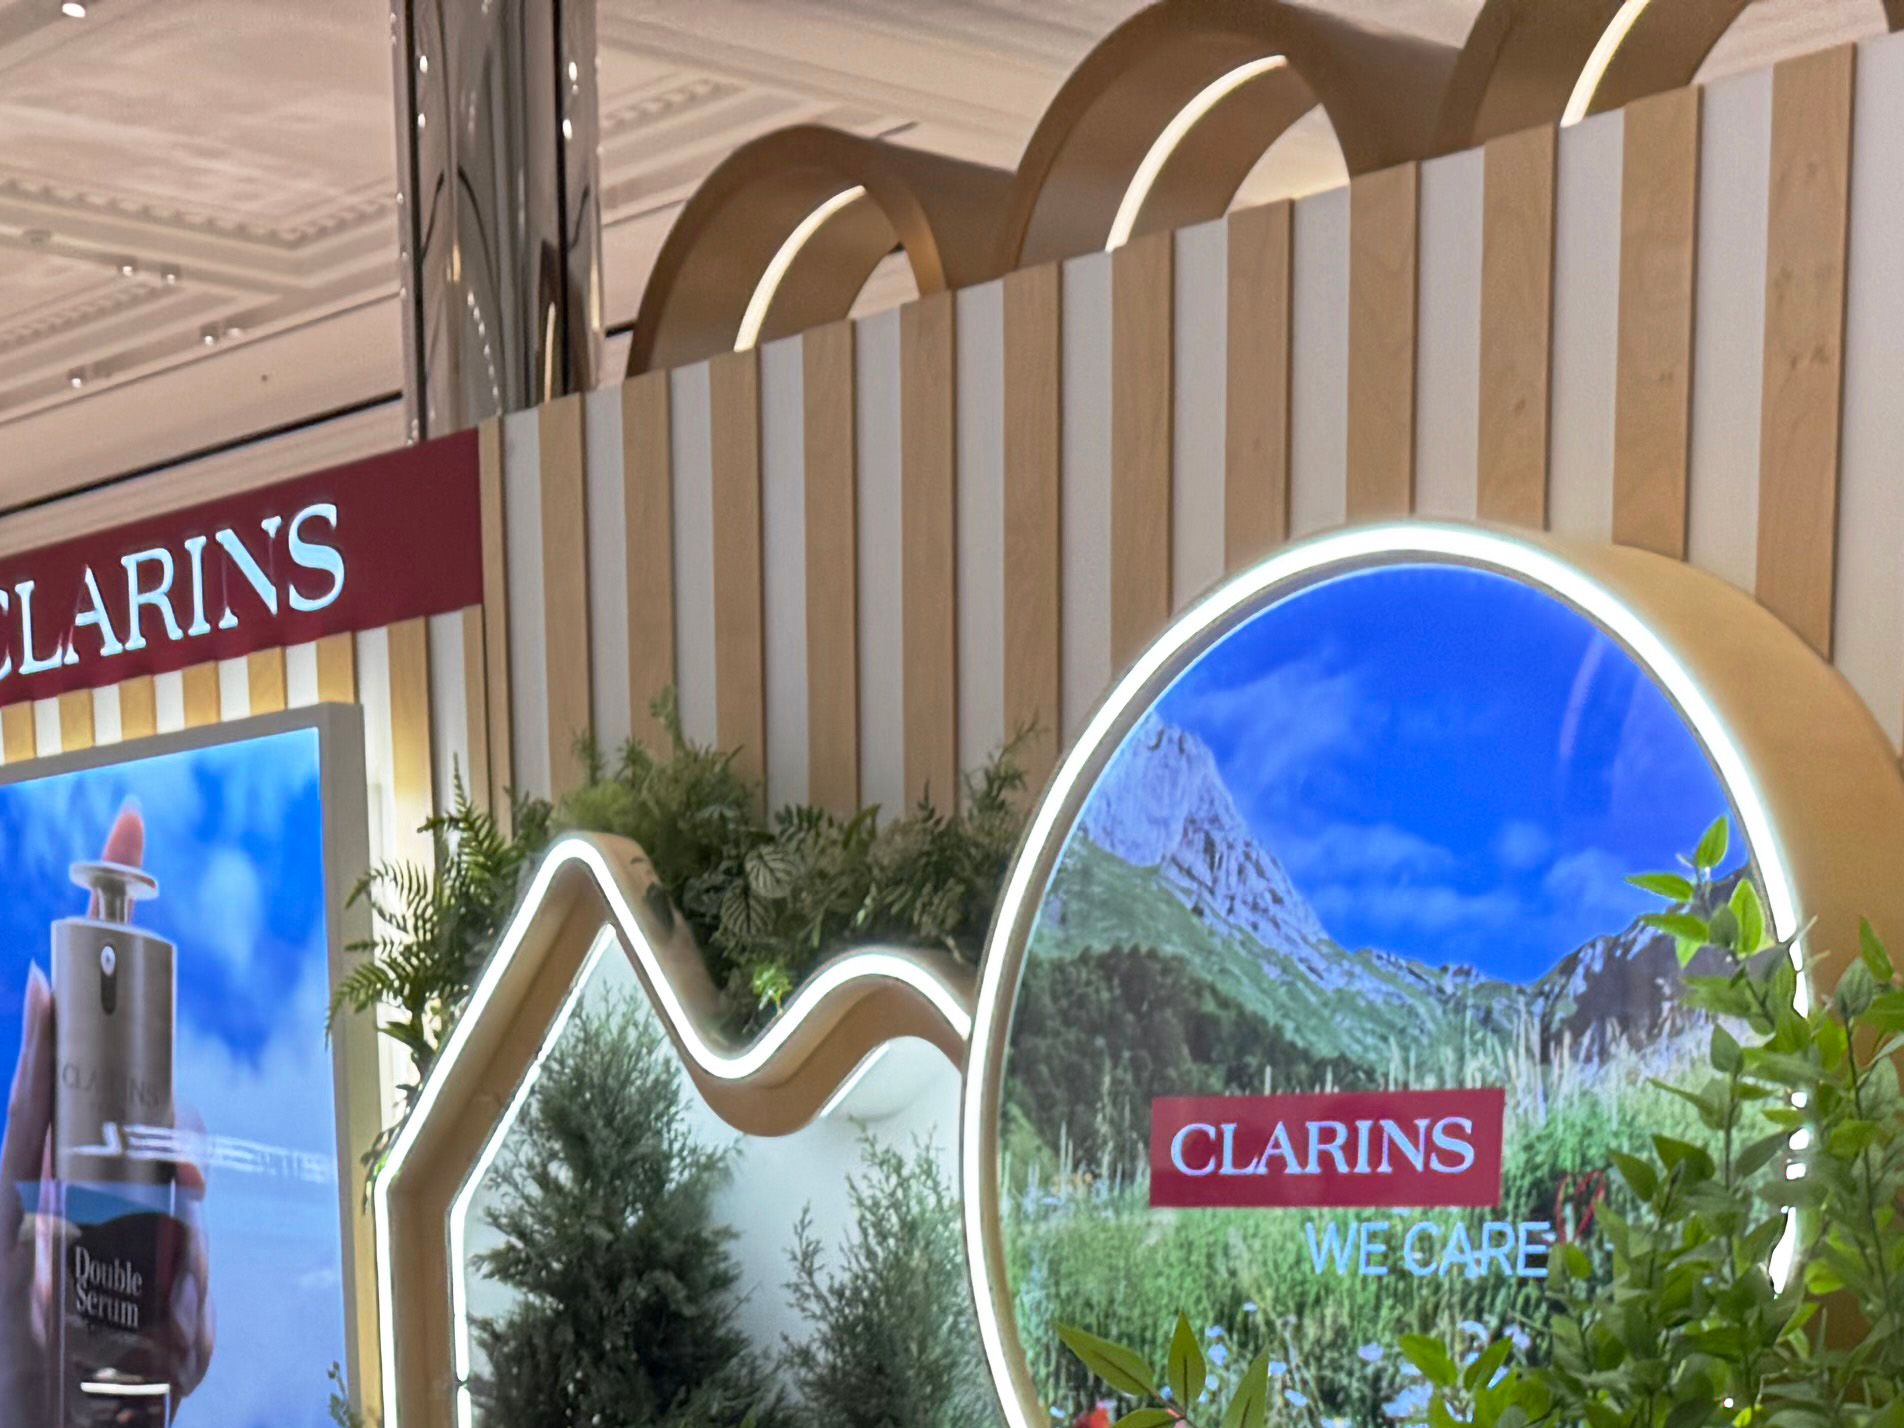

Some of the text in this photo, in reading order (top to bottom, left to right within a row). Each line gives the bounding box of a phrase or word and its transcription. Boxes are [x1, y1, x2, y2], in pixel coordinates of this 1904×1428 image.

[1170, 1117, 1475, 1176] CLARINS
[75, 1245, 143, 1297] Double
[1305, 1221, 1549, 1278] WE CARE
[75, 1276, 139, 1329] Serum
